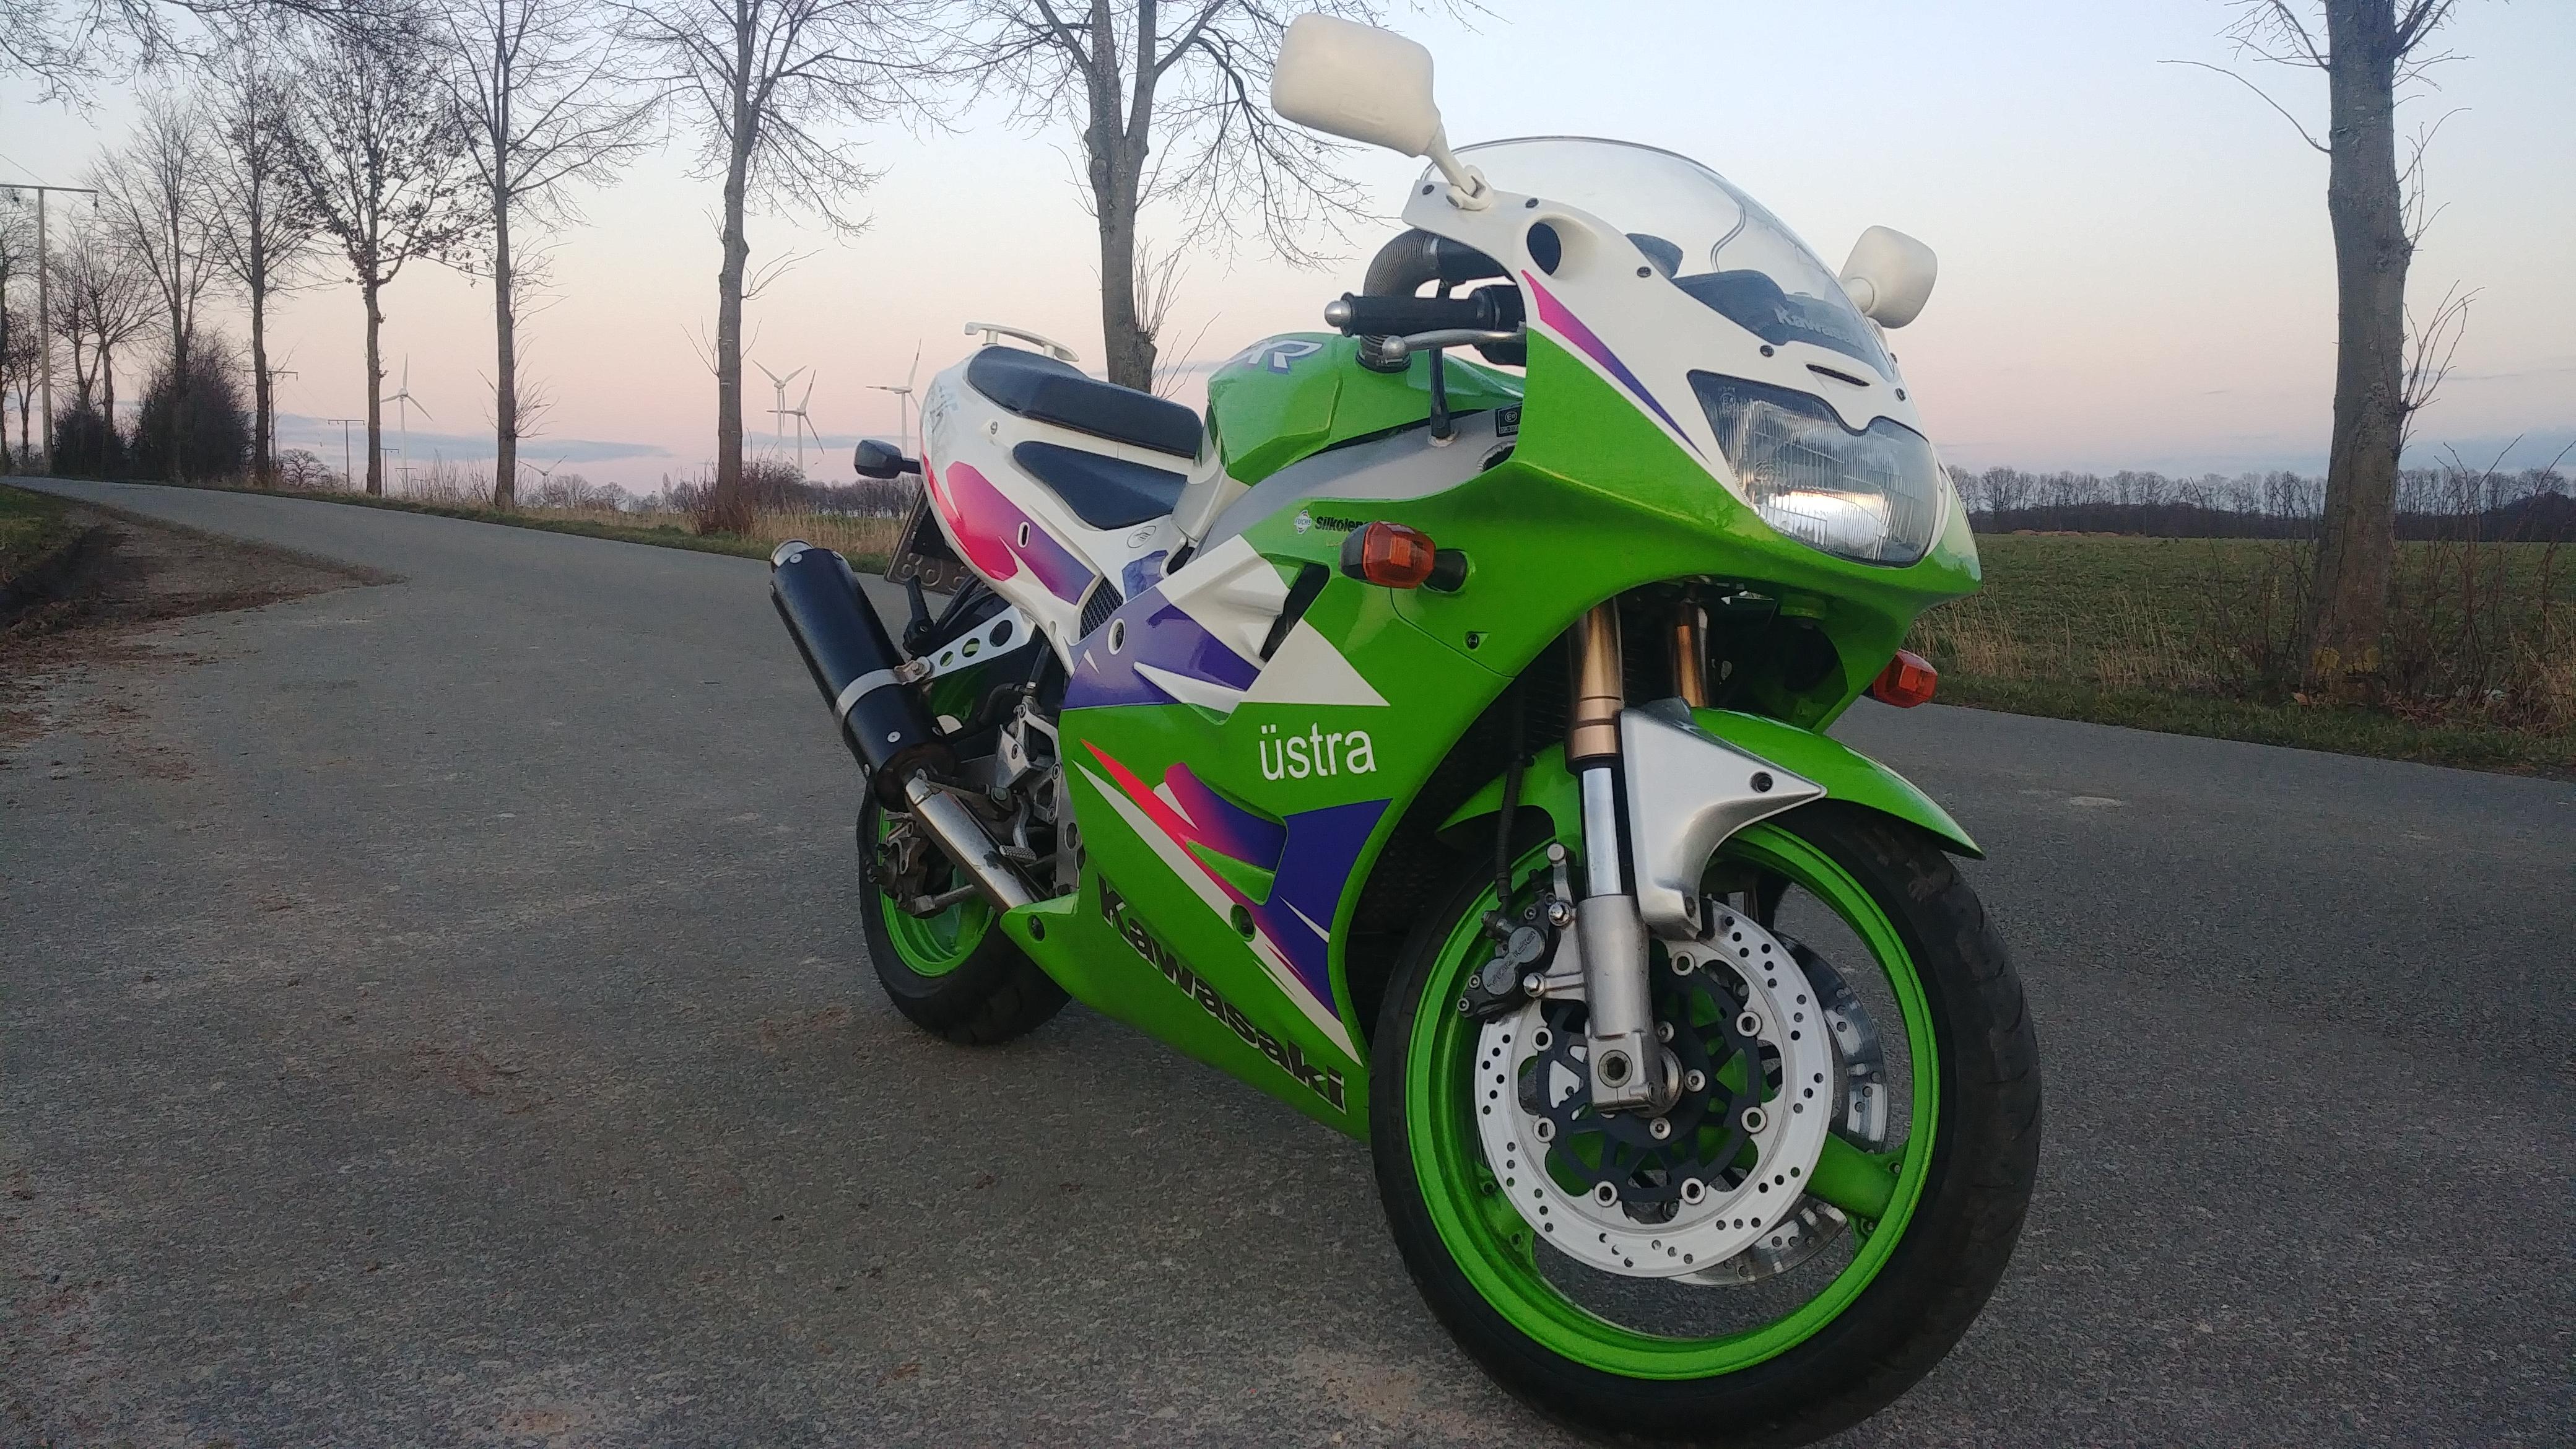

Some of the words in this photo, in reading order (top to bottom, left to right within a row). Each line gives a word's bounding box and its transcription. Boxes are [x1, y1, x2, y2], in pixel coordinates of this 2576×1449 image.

[1295, 518, 1312, 526] FUCHS
[1315, 516, 1370, 532] Silkolen
[1259, 722, 1377, 781] üstra
[1097, 873, 1347, 1115] Kawasaki
